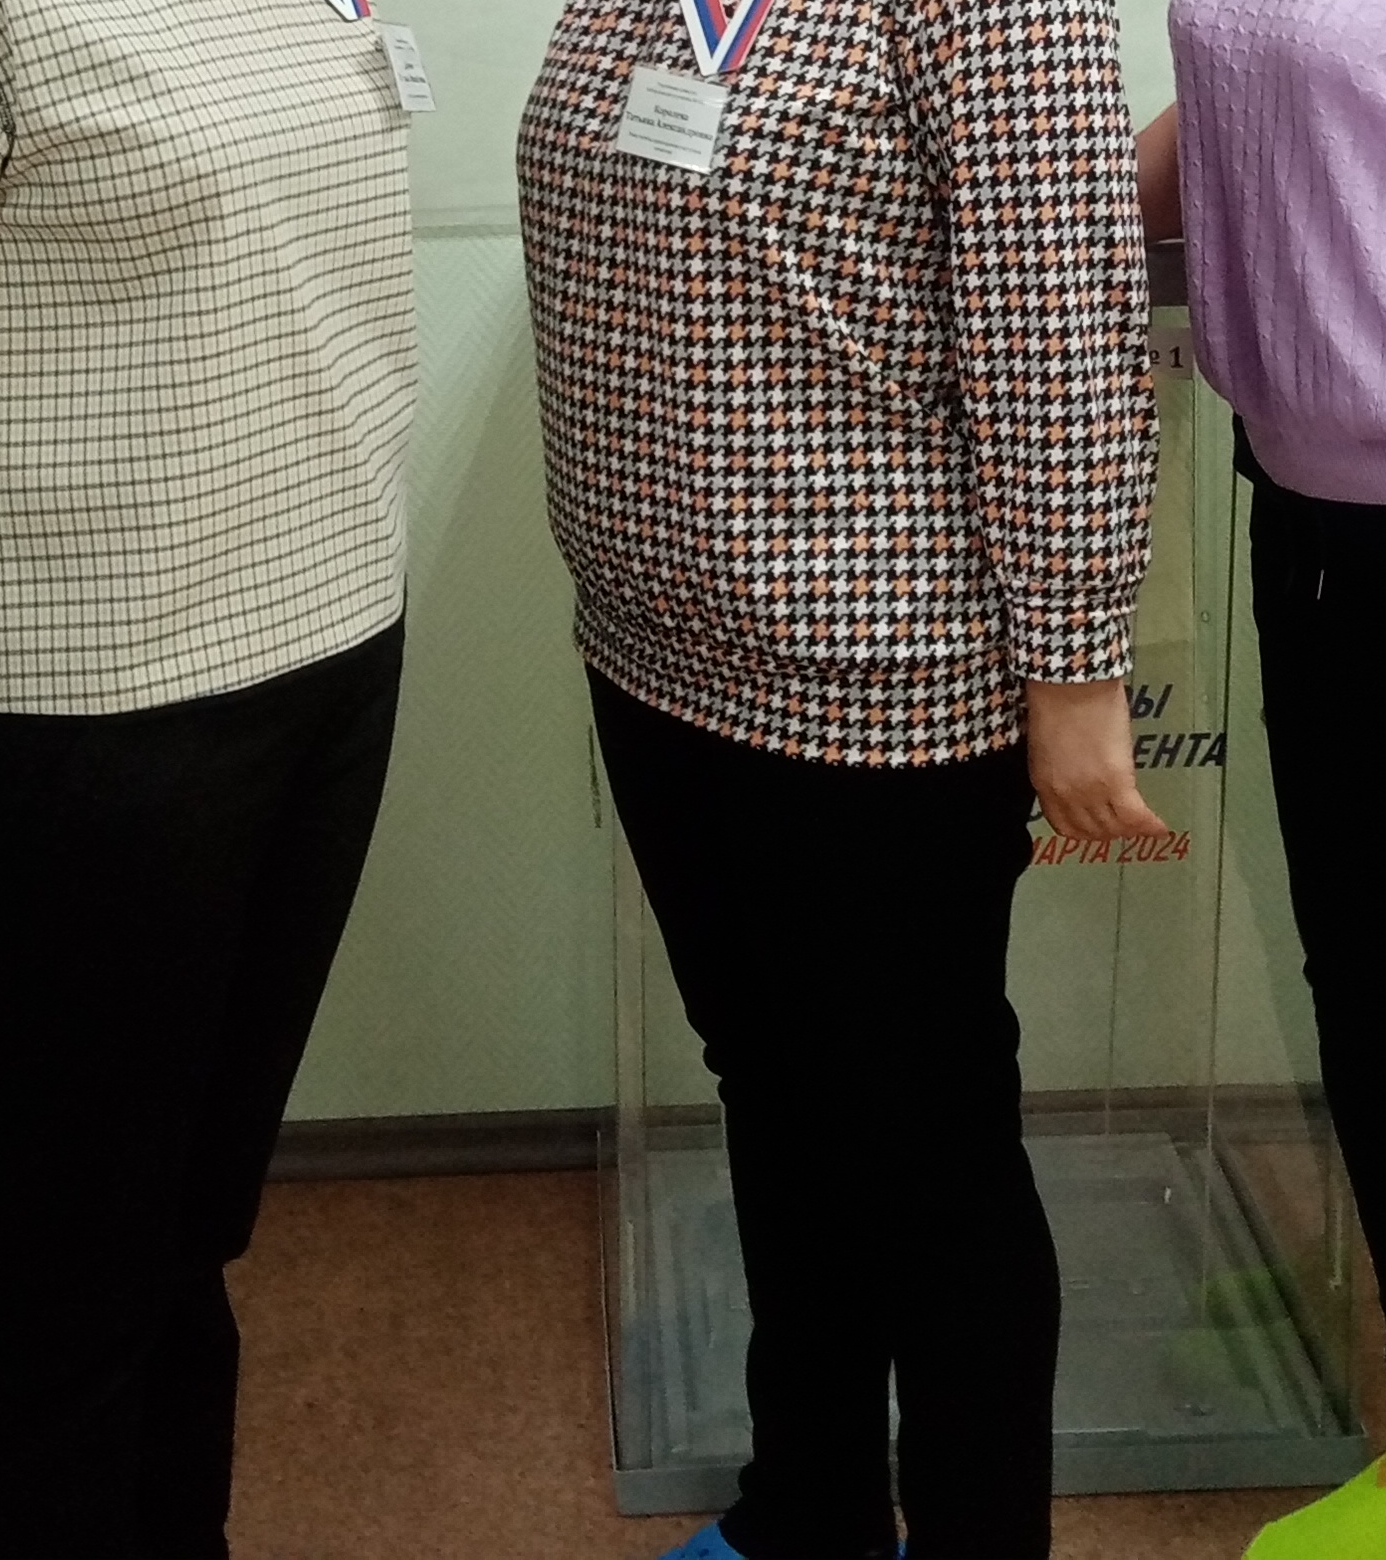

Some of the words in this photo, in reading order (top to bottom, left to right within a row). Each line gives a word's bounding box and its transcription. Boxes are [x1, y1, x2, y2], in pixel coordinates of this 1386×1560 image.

[1169, 346, 1183, 368] 1
[1032, 836, 1111, 865] АРТА
[1117, 830, 1191, 863] 2024
